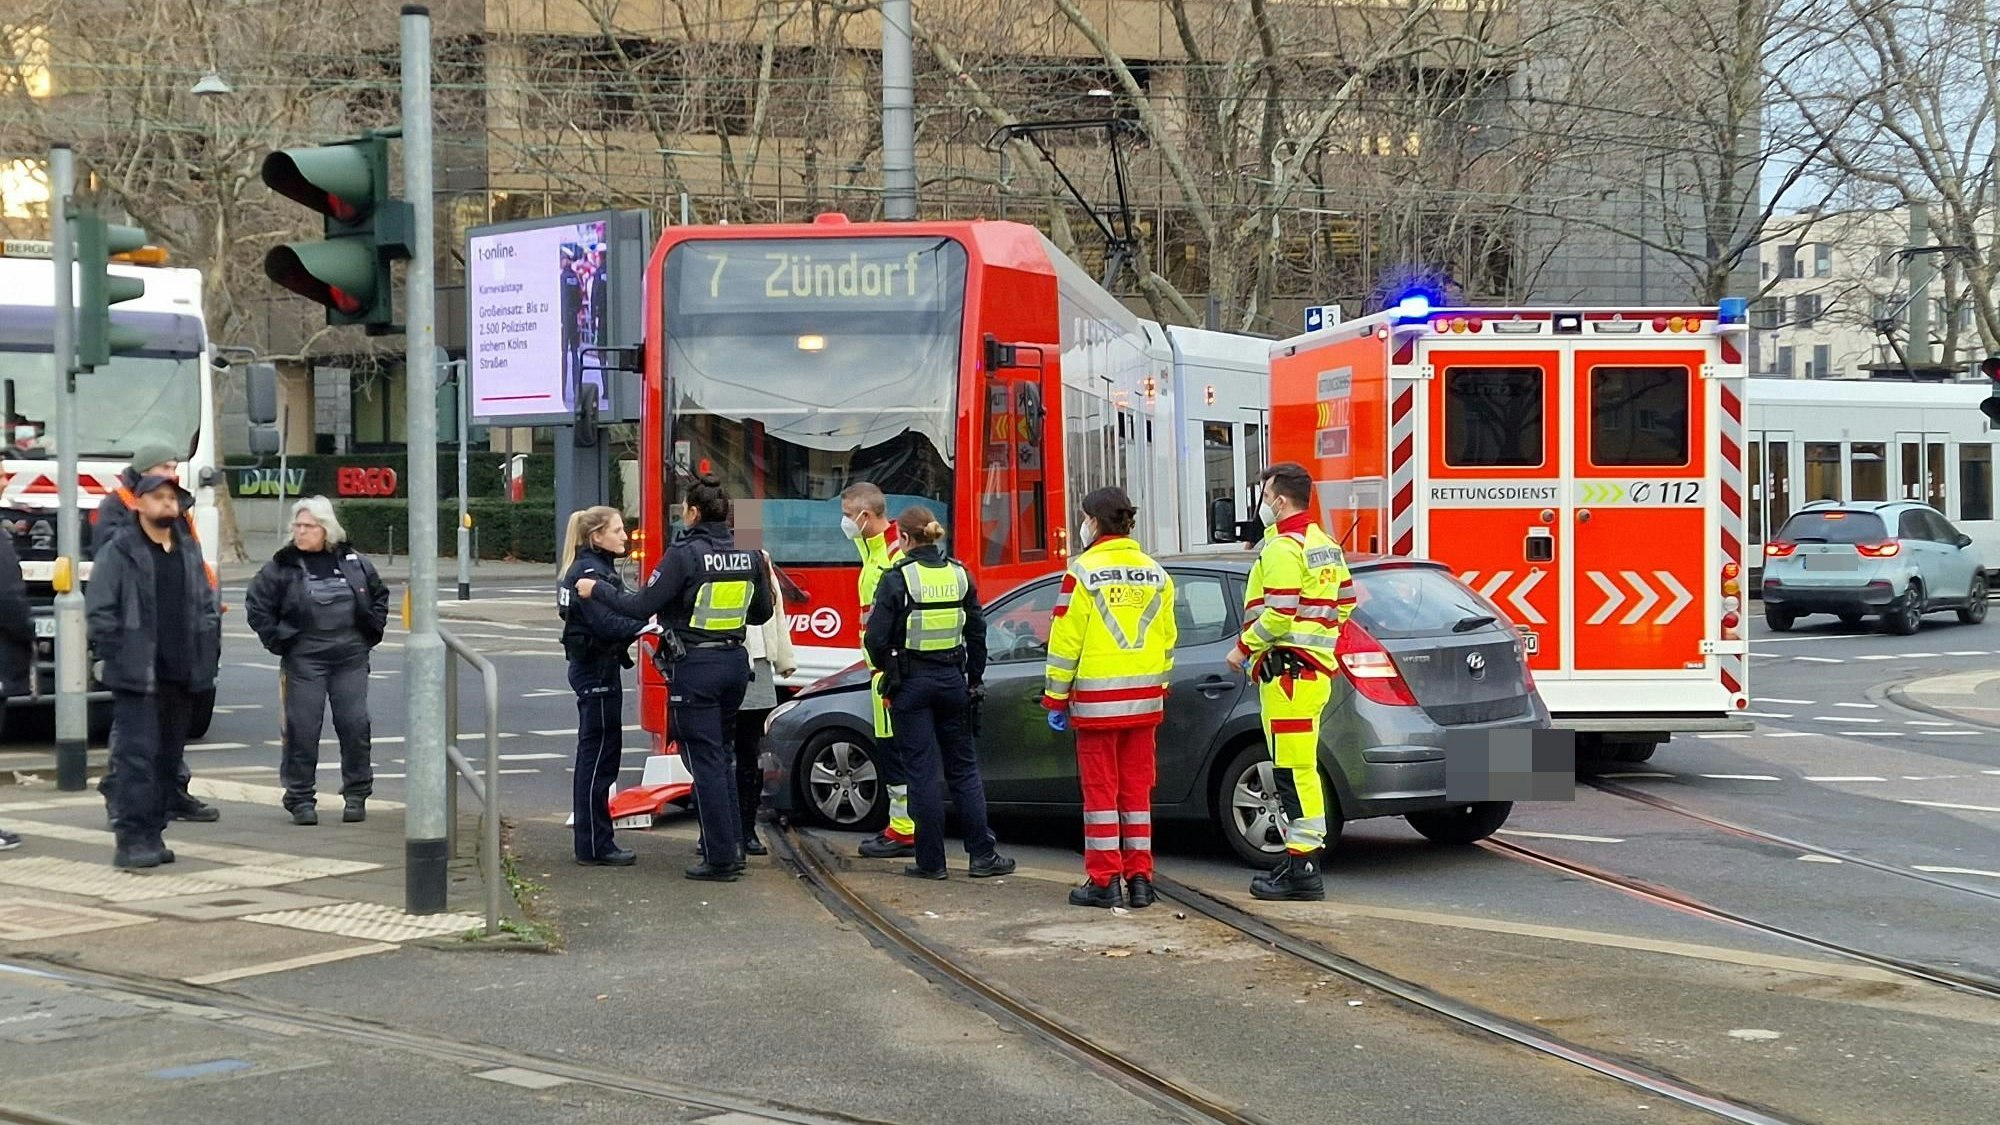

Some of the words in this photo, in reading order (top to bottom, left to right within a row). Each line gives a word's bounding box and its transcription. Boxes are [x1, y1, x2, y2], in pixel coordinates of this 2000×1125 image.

[6, 243, 49, 254] BERGU
[479, 243, 517, 260] t-online.
[706, 252, 728, 298] 7
[765, 252, 918, 297] Zündorf
[479, 283, 523, 295] Karnevalstage
[479, 305, 524, 318] Großeinsatz:
[526, 303, 538, 313] Bis
[540, 303, 549, 312] zu
[479, 323, 499, 335] 2.500
[501, 321, 537, 334] Polizisten
[480, 341, 506, 352] sichern
[507, 339, 528, 350] Kölns
[480, 357, 508, 369] Straßen
[239, 468, 307, 495] DKV
[337, 467, 398, 496] ERGO
[1431, 487, 1557, 500] RETTUNGSDIENST
[1658, 482, 1700, 503] 112
[703, 553, 752, 571] POLIZEI
[1089, 569, 1122, 585] ASB
[1126, 569, 1160, 582] Köln
[922, 584, 959, 598] POLIZEI
[784, 614, 810, 632] VB
